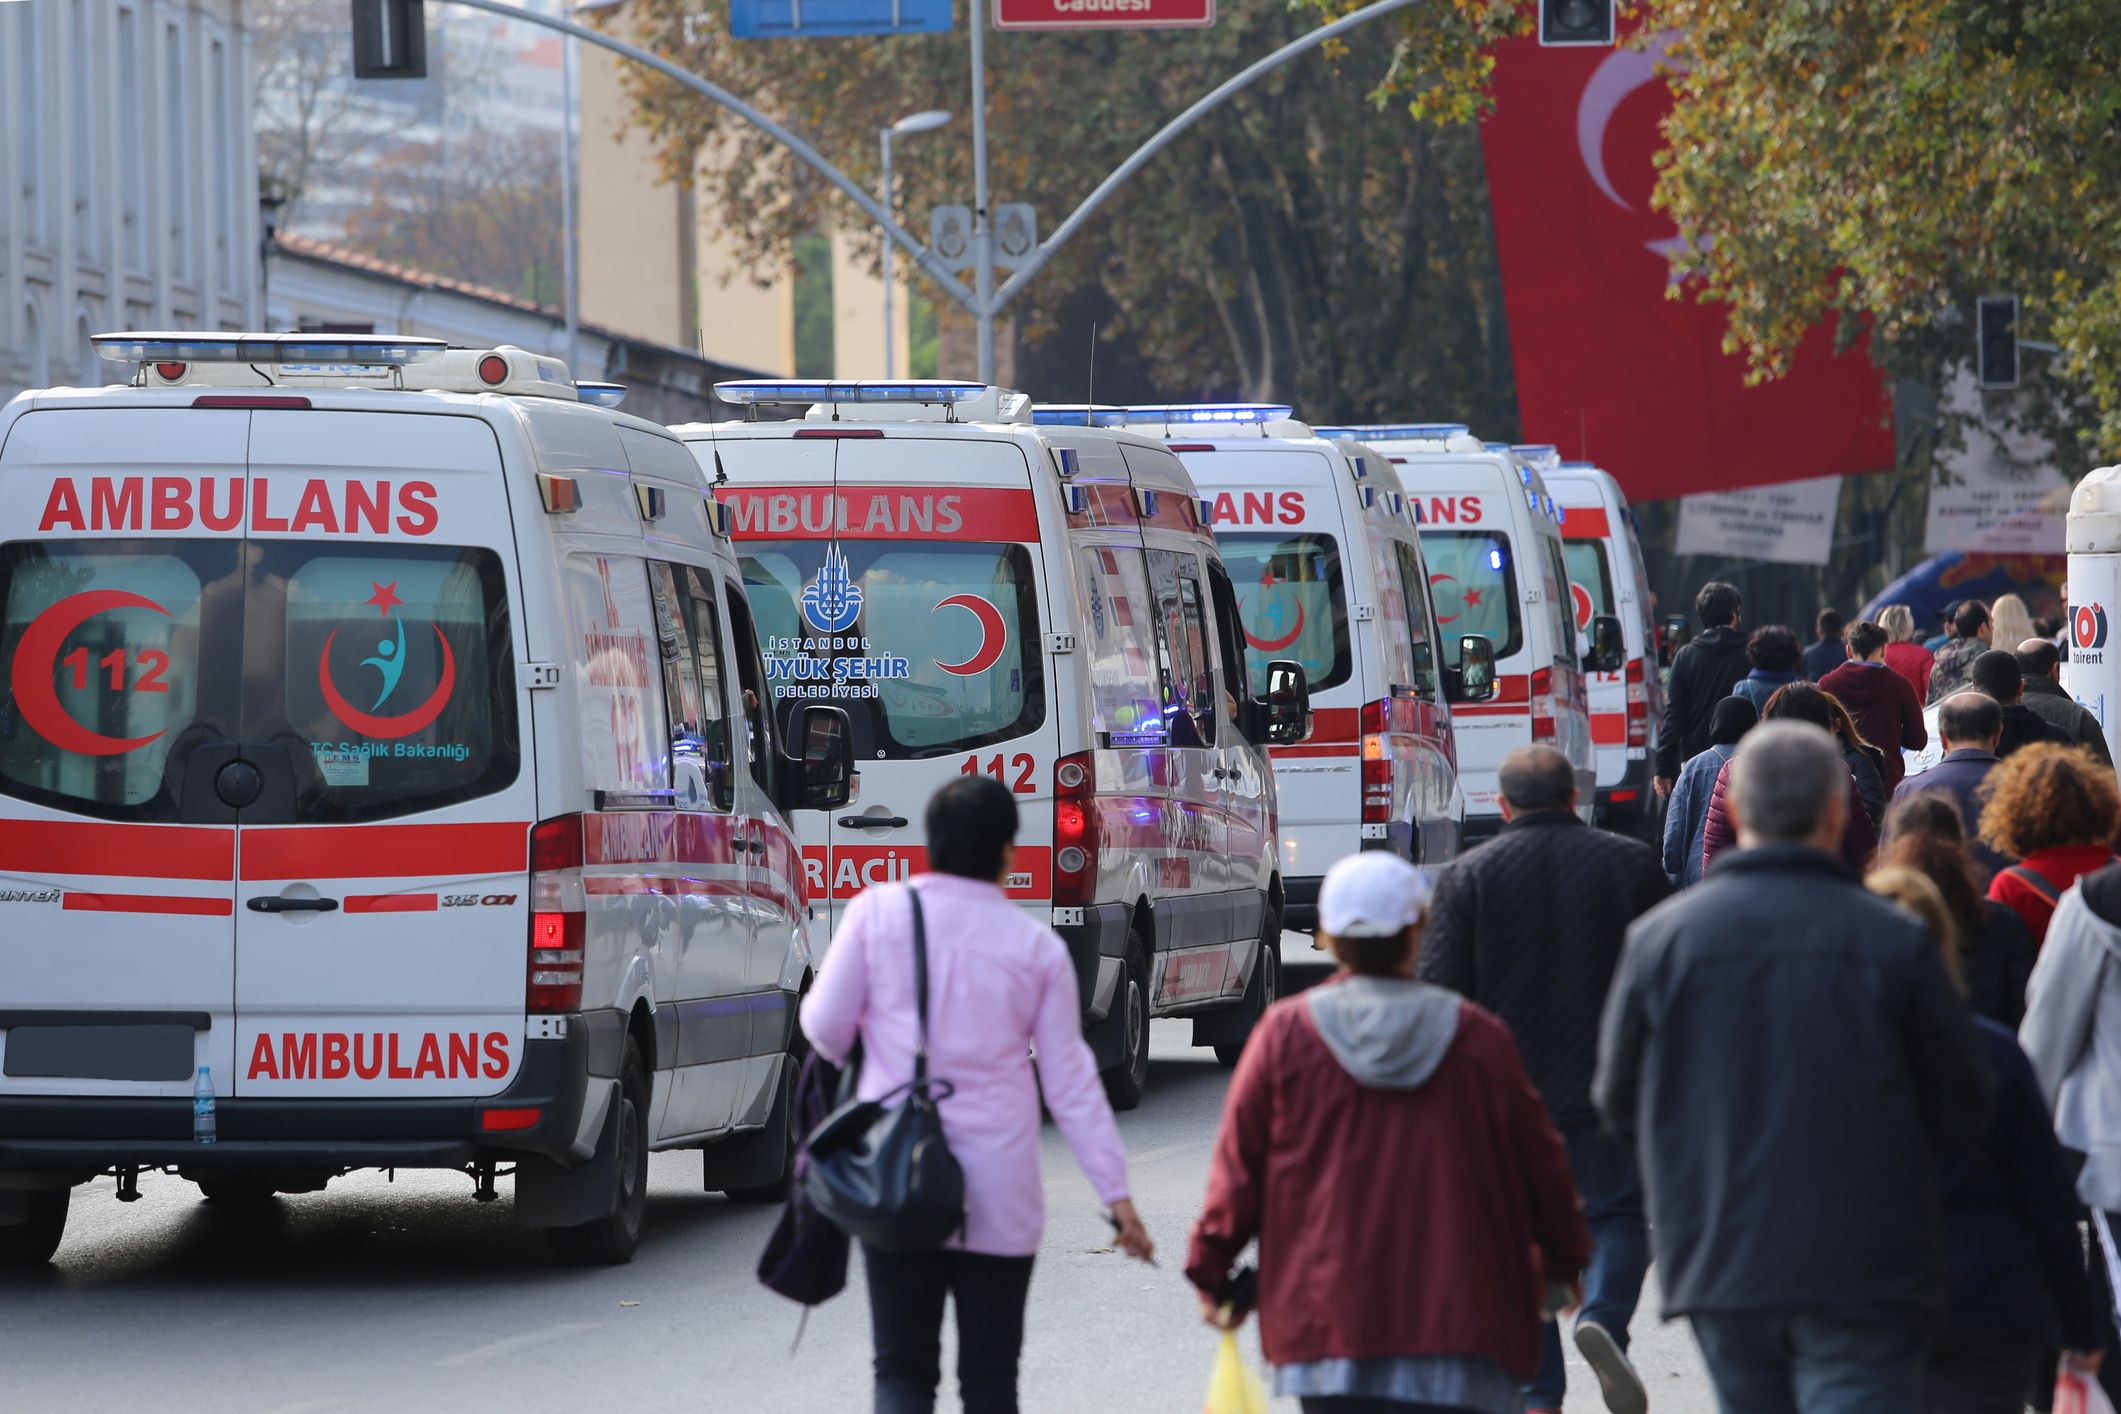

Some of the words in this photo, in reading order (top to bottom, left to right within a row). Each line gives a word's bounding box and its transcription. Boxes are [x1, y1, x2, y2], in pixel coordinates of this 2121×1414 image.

[38, 475, 440, 537] AMBULANS
[725, 493, 963, 533] MBULANS
[1211, 491, 1306, 526] ANS
[1410, 496, 1483, 524] ANS
[769, 635, 872, 650] İSTANBUL
[2073, 651, 2103, 664] toirent
[63, 646, 171, 693] 112
[763, 652, 830, 680] ÜYÜK
[833, 651, 909, 684] ŞEHİR
[775, 683, 879, 698] BELEDİYESİ
[394, 743, 470, 761] Bakanlığı
[961, 753, 1036, 794] 112
[804, 858, 825, 889] R
[481, 894, 518, 906] CDI
[247, 1030, 510, 1081] AMBULANS
